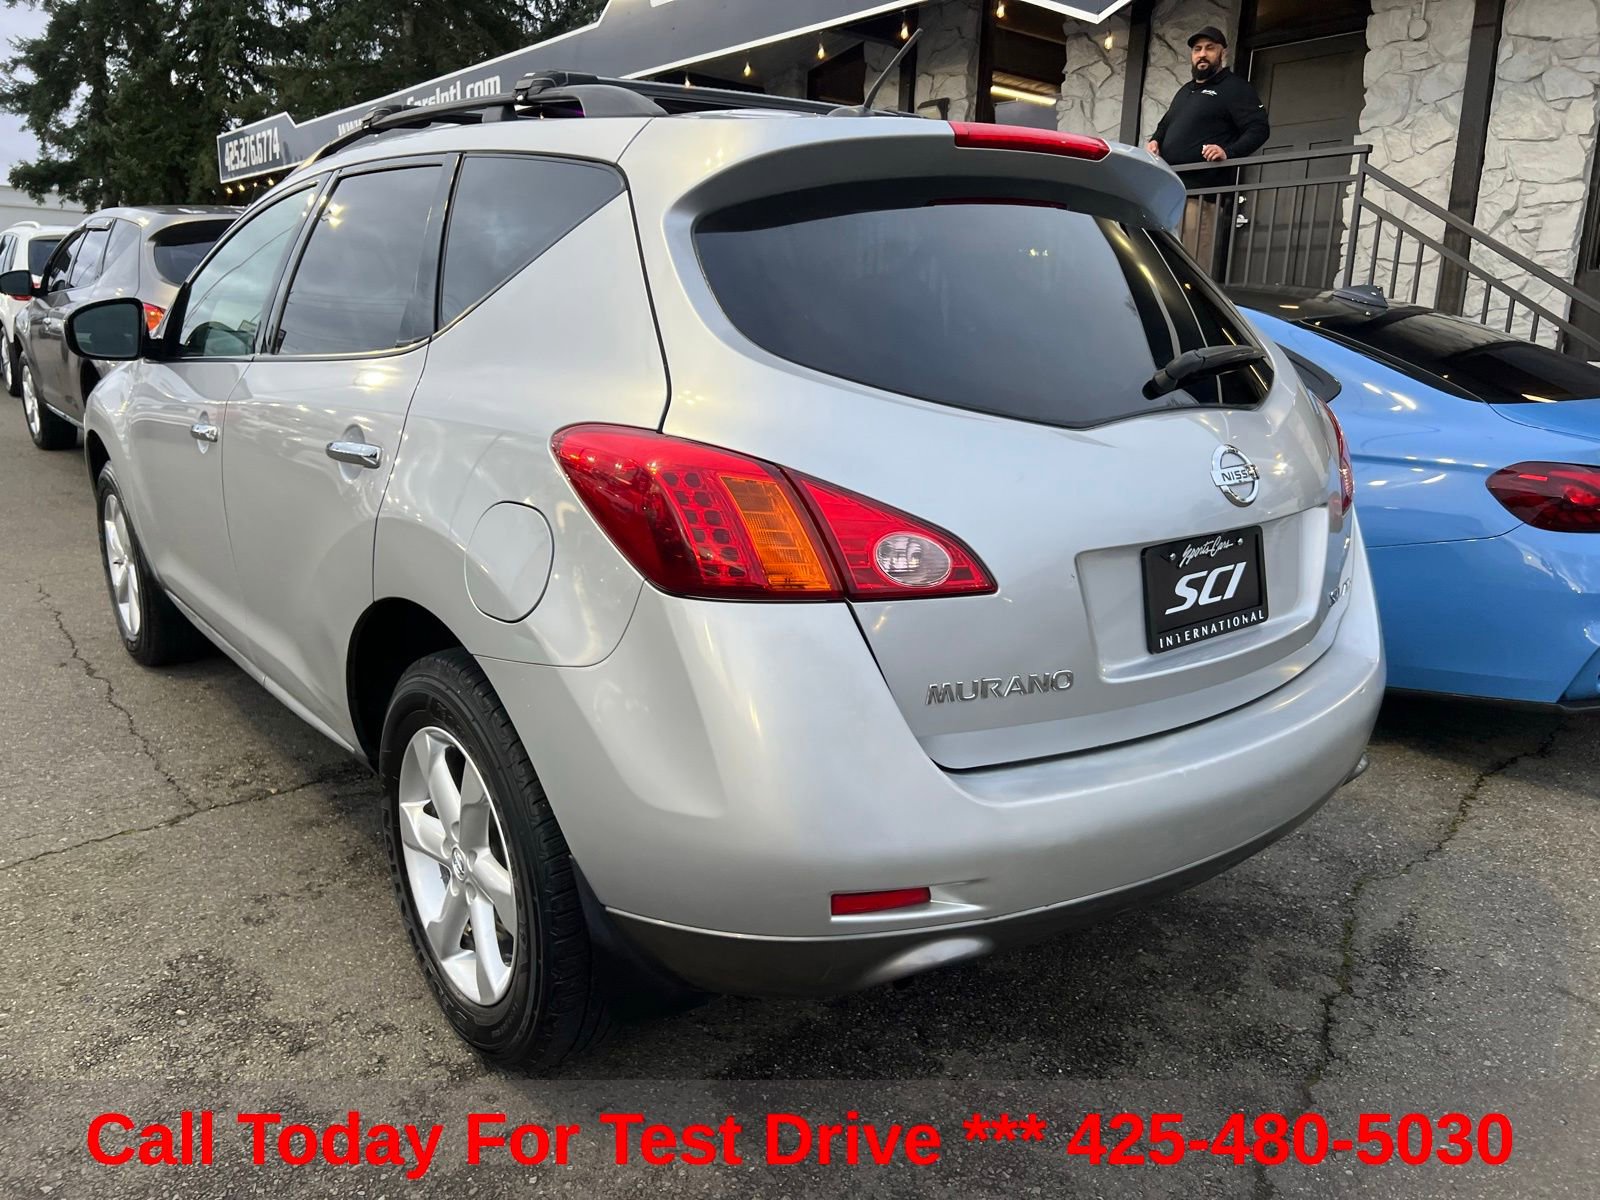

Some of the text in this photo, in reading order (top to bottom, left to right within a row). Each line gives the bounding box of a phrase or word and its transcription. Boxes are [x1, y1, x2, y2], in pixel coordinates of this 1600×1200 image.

[1179, 535, 1233, 568] Sports Cars
[1164, 561, 1247, 615] SCI
[1159, 609, 1265, 649] INTERNATIONAL
[926, 669, 1075, 705] MURANO
